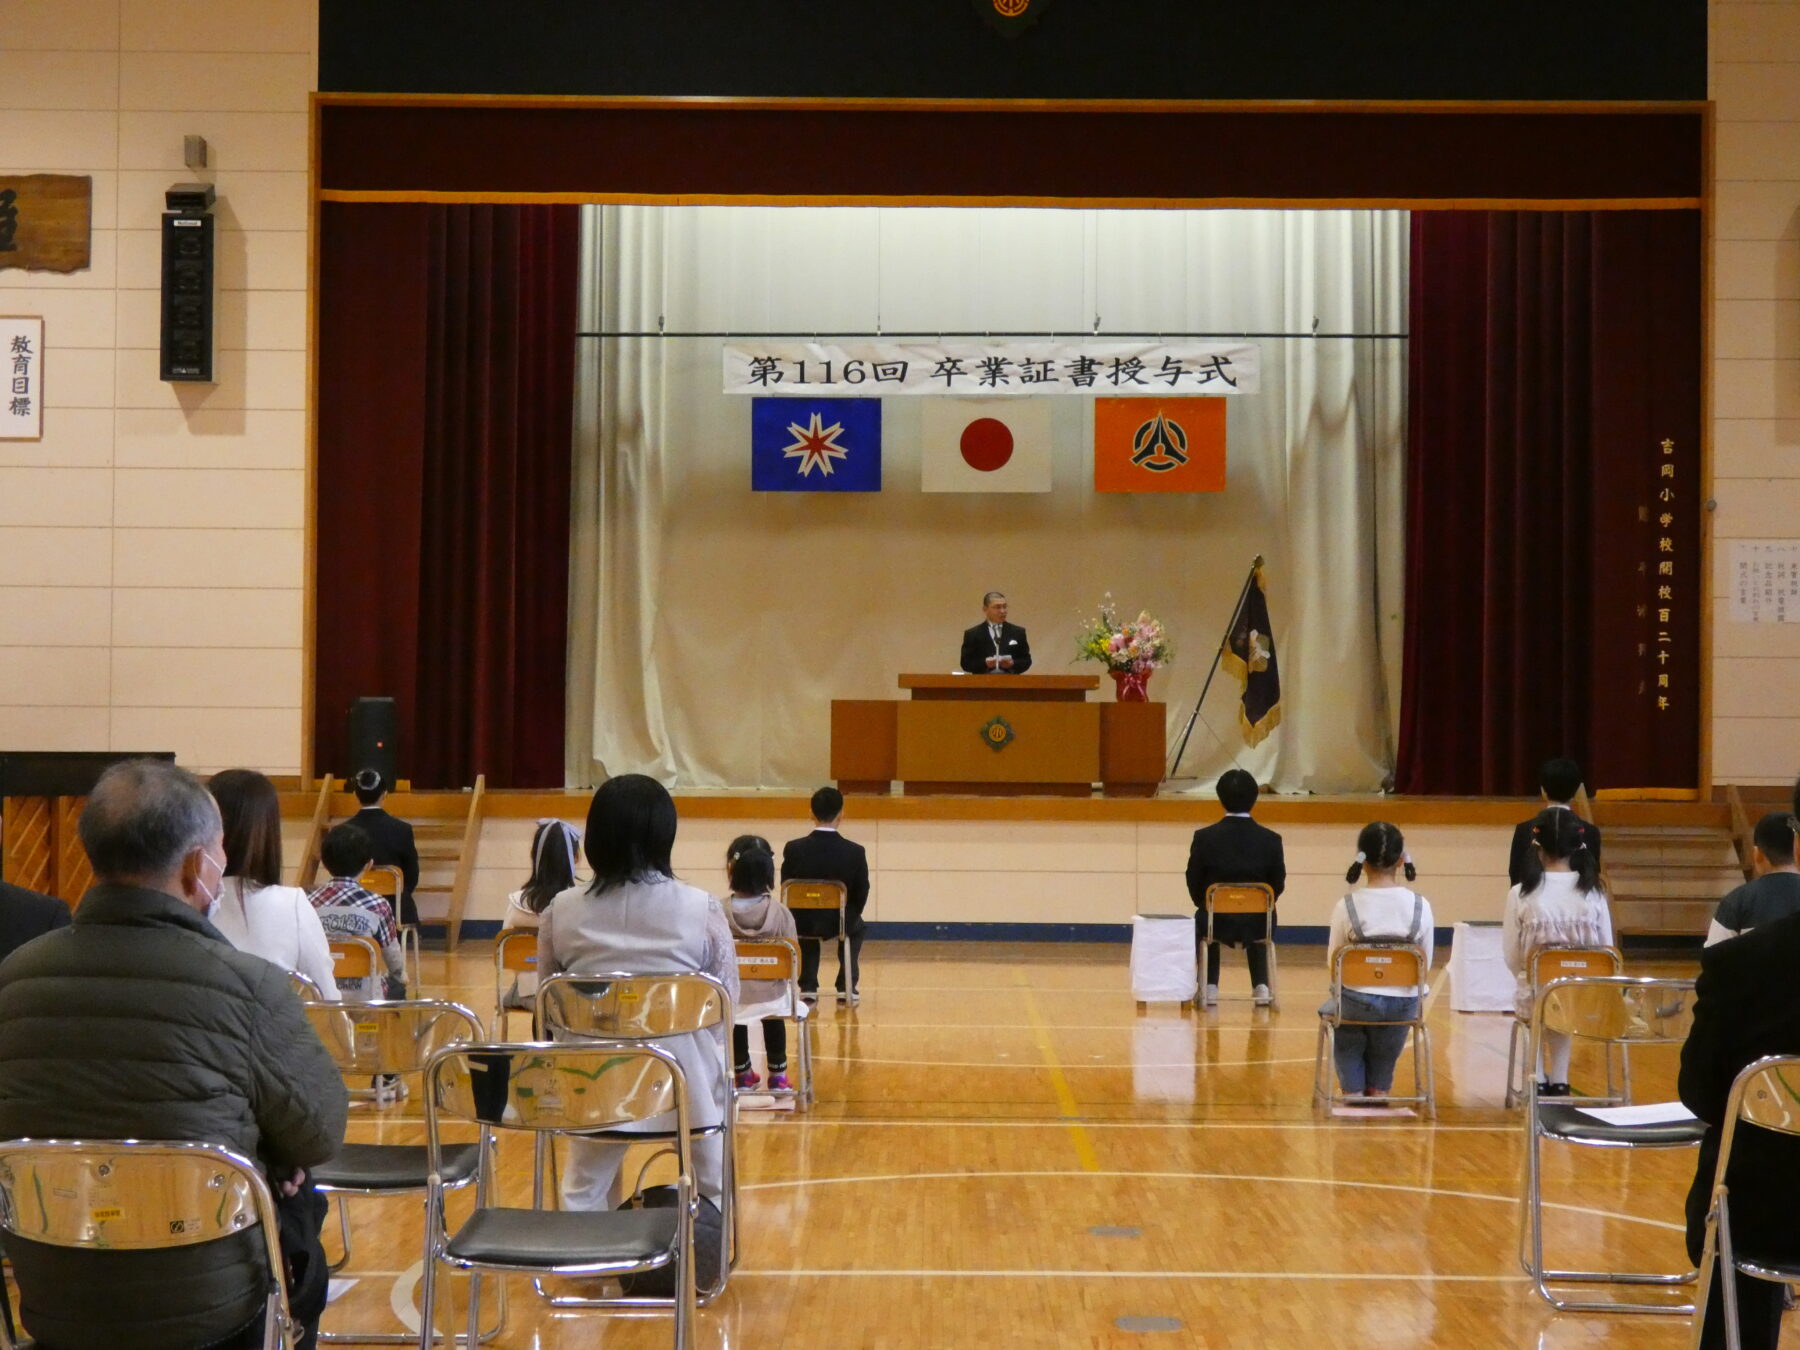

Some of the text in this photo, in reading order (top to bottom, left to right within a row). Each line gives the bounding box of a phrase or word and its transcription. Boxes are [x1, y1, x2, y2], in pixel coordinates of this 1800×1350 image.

[9, 335, 34, 417] 教育目標
[747, 354, 1238, 388] 第116回 卒業証書授与式
[1657, 437, 1676, 711] 吉岡小学校開校百二十周年
